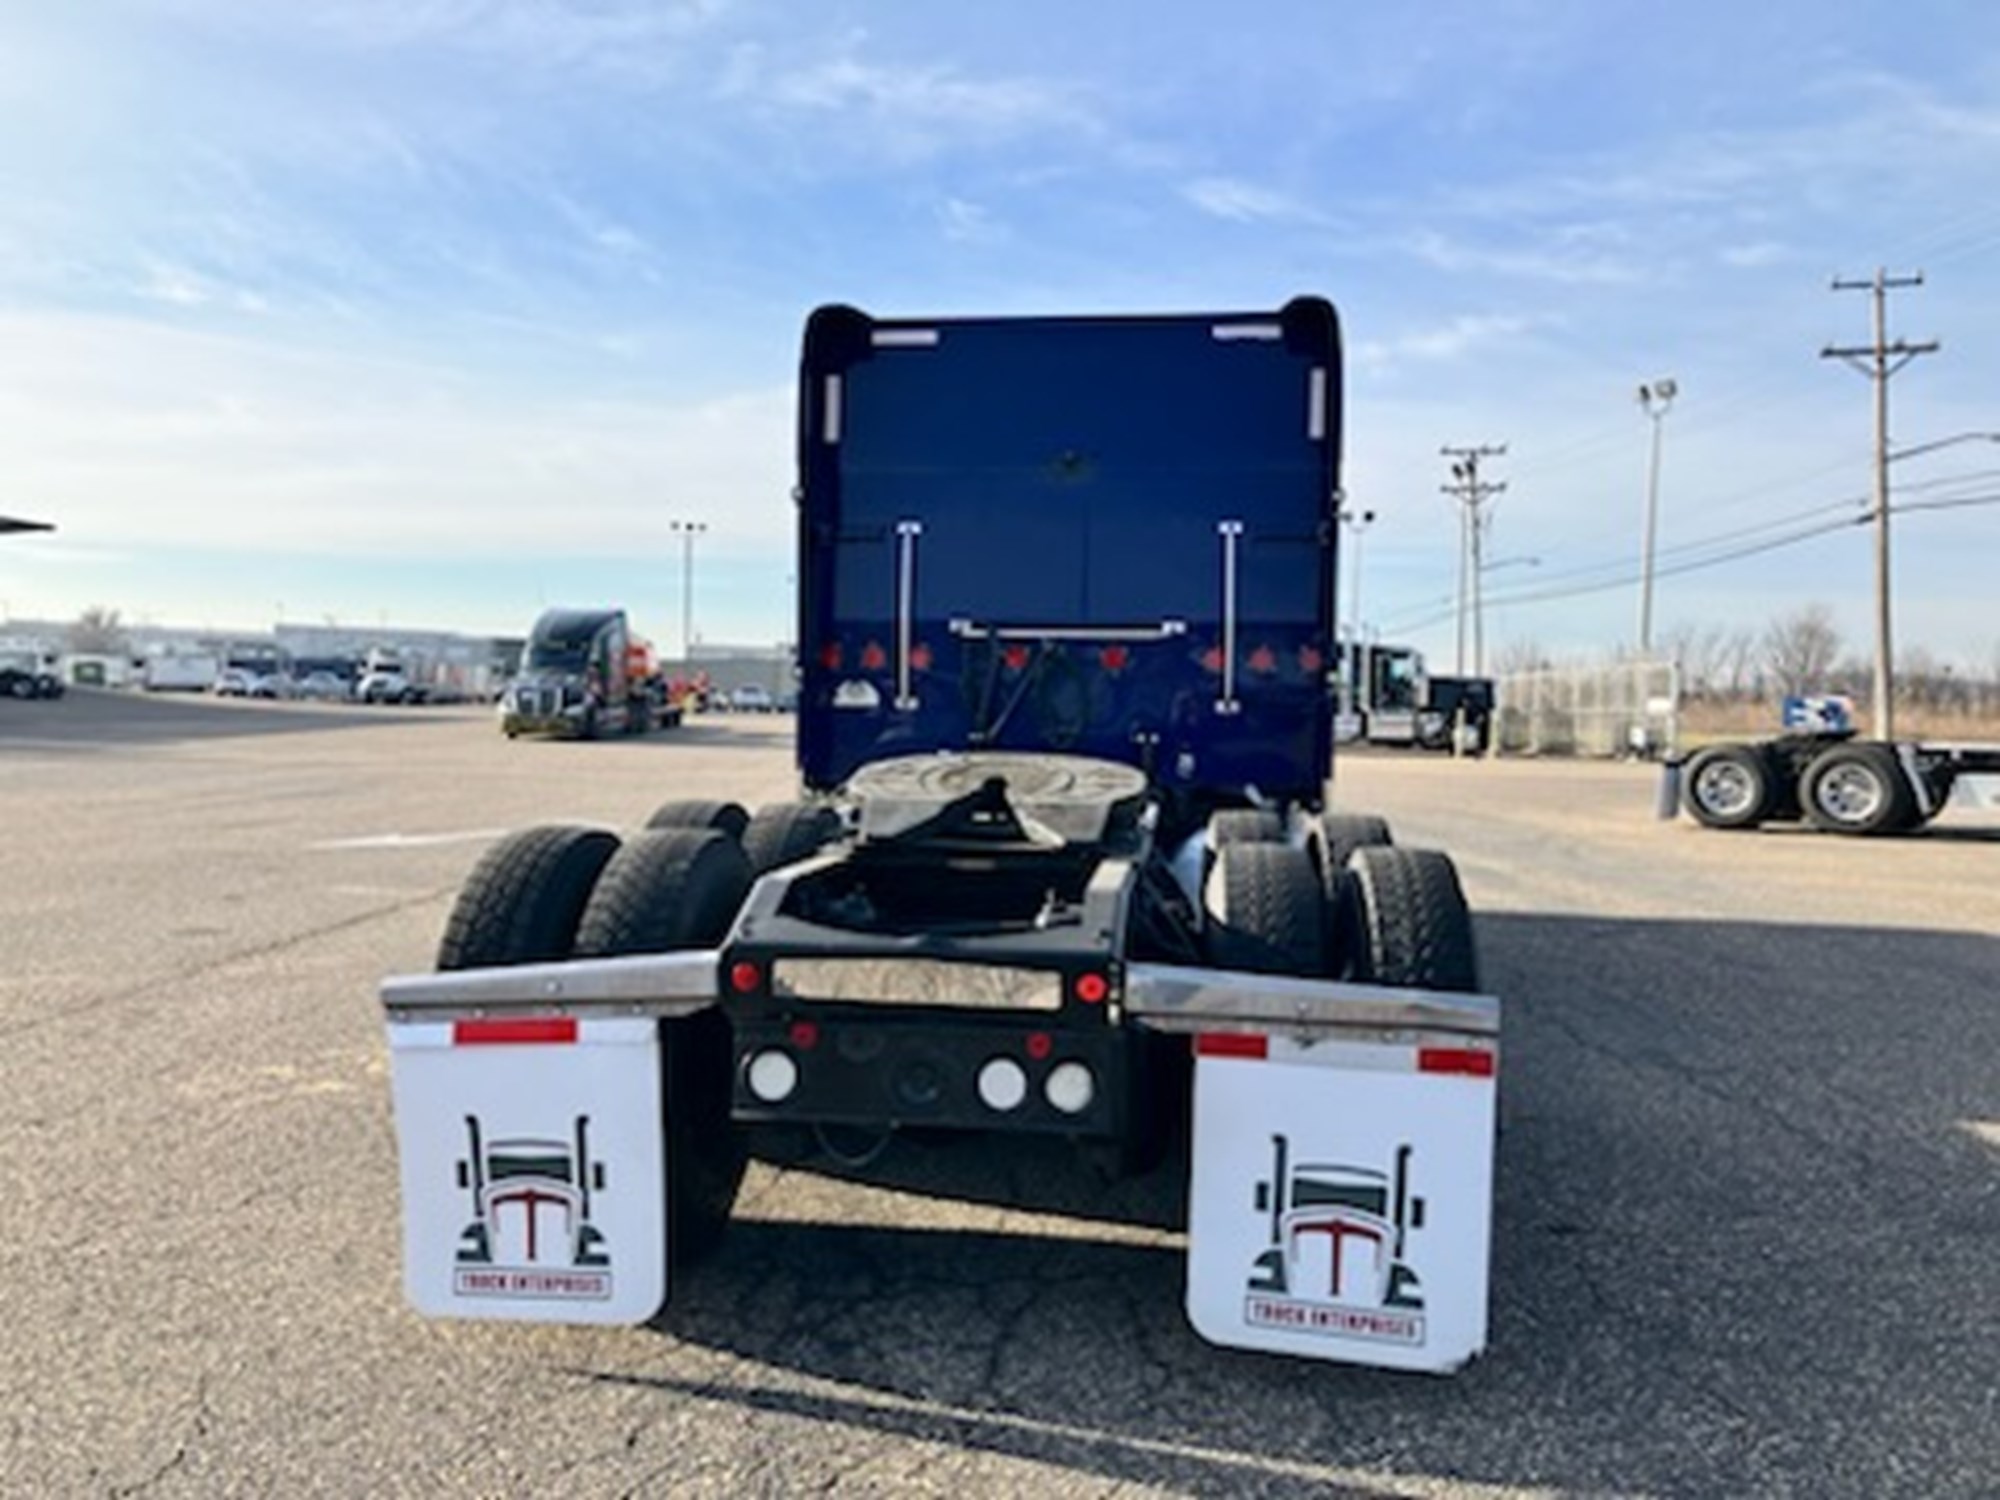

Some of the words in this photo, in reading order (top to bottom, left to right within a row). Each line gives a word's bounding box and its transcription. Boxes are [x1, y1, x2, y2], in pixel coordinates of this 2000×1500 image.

[462, 1273, 506, 1289] TRUCK
[1254, 1303, 1305, 1324] TRUCK
[1311, 1310, 1415, 1338] ENTERPRISES
